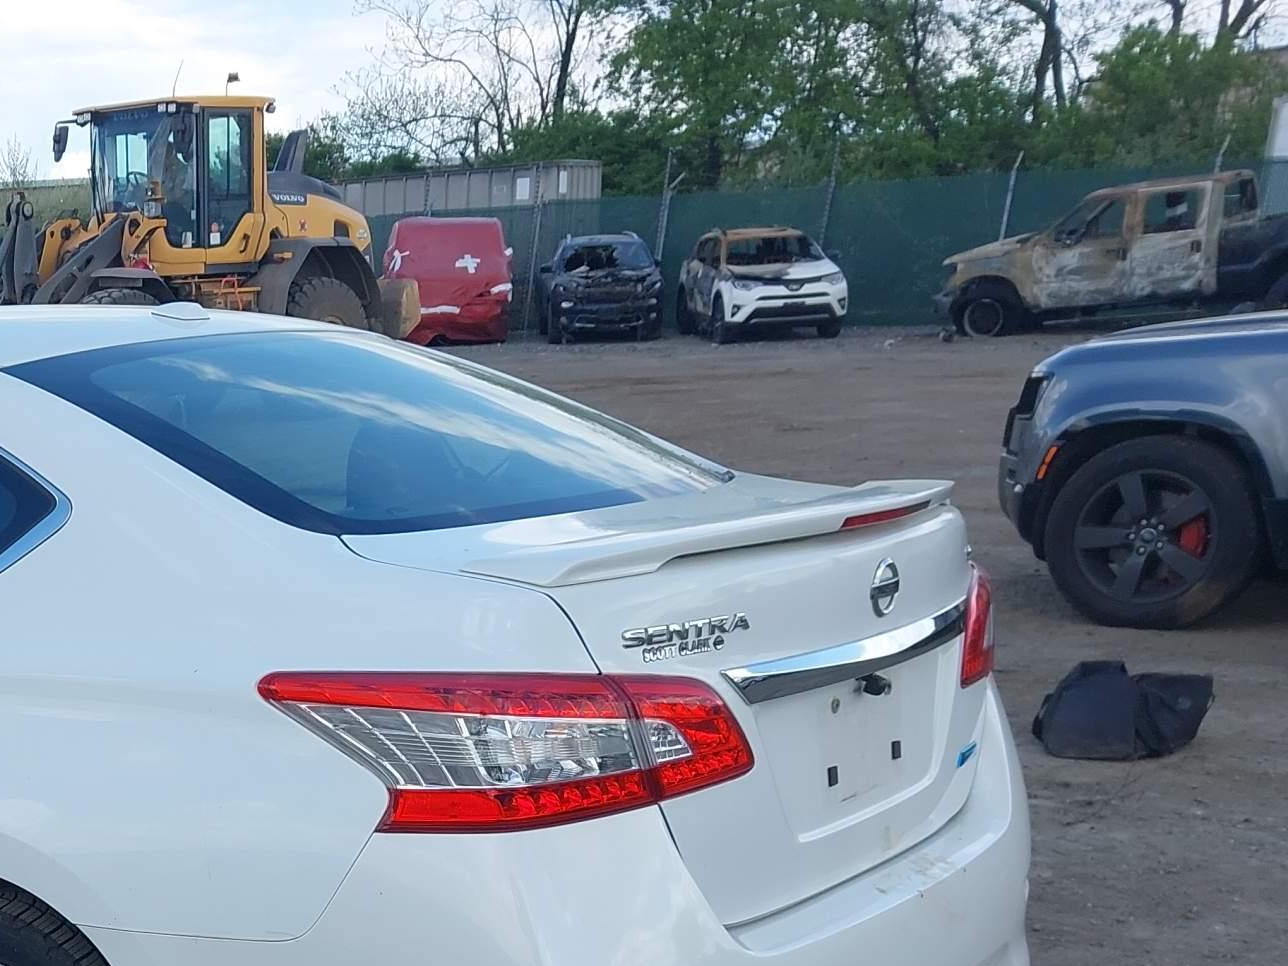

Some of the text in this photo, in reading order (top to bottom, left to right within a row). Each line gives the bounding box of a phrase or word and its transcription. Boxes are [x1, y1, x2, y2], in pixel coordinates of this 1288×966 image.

[272, 193, 304, 202] VOLVO
[621, 612, 750, 649] SENTRA
[642, 637, 712, 663] SCOTT CLARK
